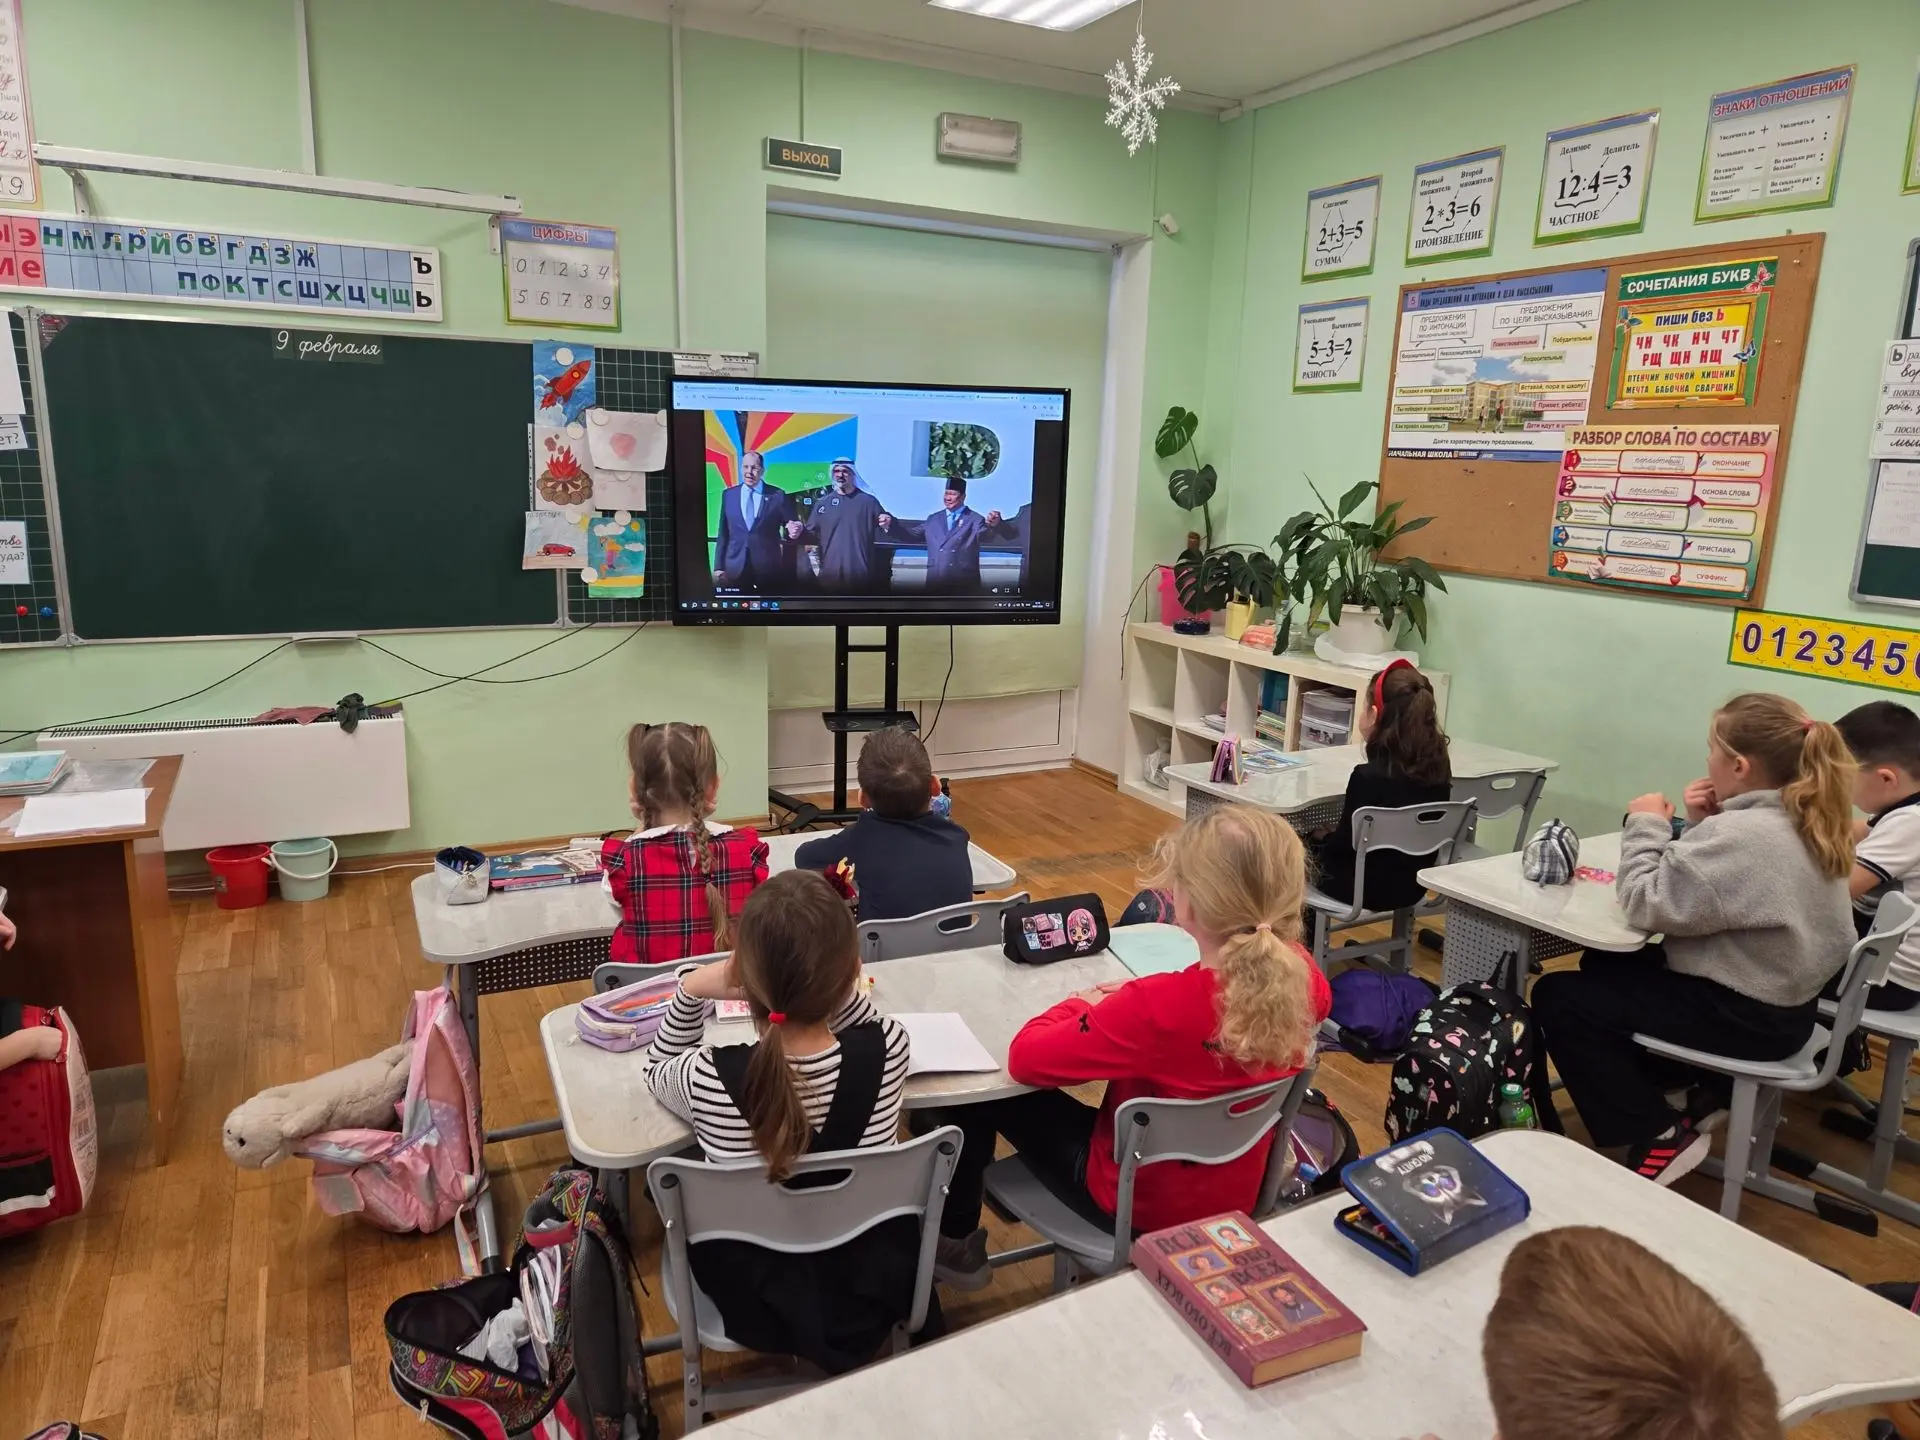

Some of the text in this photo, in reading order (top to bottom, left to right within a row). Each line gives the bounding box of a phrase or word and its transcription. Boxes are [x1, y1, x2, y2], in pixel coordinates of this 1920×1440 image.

[1714, 75, 1849, 116] ЗНАКИ ОТНОШЕНИЙ
[1602, 143, 1640, 156] Делитель
[782, 148, 830, 168] ВЫХОД
[1461, 168, 1483, 178] Второй
[1421, 176, 1444, 187] Первый
[1558, 165, 1632, 200] 12:4=3
[1550, 210, 1600, 226] ЧАСТНОЕ
[532, 226, 588, 243] ЦИФРЫ
[1319, 220, 1364, 246] 2+3=5
[1415, 230, 1484, 248] ПРОИЗВЕДЕНИЕ
[516, 259, 610, 279] 0 1 2 3 4
[1315, 256, 1342, 266] СУММА
[1628, 269, 1750, 294] СОЧЕТАНИЯ БУКВ
[518, 289, 610, 310] 5 6 7 8 9
[1520, 303, 1572, 314] ПРЕДЛОЖЕНИЯ
[1422, 314, 1466, 322] ПРЕДЛОЖЕНИЯ
[1513, 316, 1531, 324] ЦЕЛИ
[1534, 310, 1592, 322] ВЫСКАЗЫВАНИЯ
[1656, 310, 1713, 326] пиши без
[276, 330, 380, 361] 9 февраля
[1636, 330, 1740, 350] ЧН ЧК НЧ ЧТ
[1642, 350, 1722, 367] РЩ ЩН НЩ
[1302, 370, 1336, 379] РАЗНОСТЬ
[1628, 374, 1659, 382] ПТЕНЧИК
[1701, 370, 1735, 379] ХИЩНИК
[1626, 382, 1734, 394] МЕЧТА БАБОЧКА СВАРЩИК
[1572, 431, 1772, 446] РАЗБОР СЛОВА ПО СОСТАВУ
[1566, 481, 1573, 490] 2
[1563, 506, 1569, 514] 3
[1560, 532, 1566, 540] 4
[1558, 552, 1564, 562] 5
[1698, 545, 1736, 554] ПРИСТАВКА
[1696, 574, 1728, 582] СУФФИКС
[1743, 623, 1762, 653] 0
[1772, 626, 1786, 657] 1
[1795, 630, 1818, 662] 2
[1824, 634, 1846, 666] 3
[1852, 638, 1875, 671] 4
[1882, 642, 1908, 676] 5
[1155, 1226, 1206, 1254] ВСЕ
[1233, 1248, 1270, 1266] ОБО
[1232, 1260, 1288, 1284] ВСЕХ
[1156, 1270, 1184, 1306] ВСЕХ
